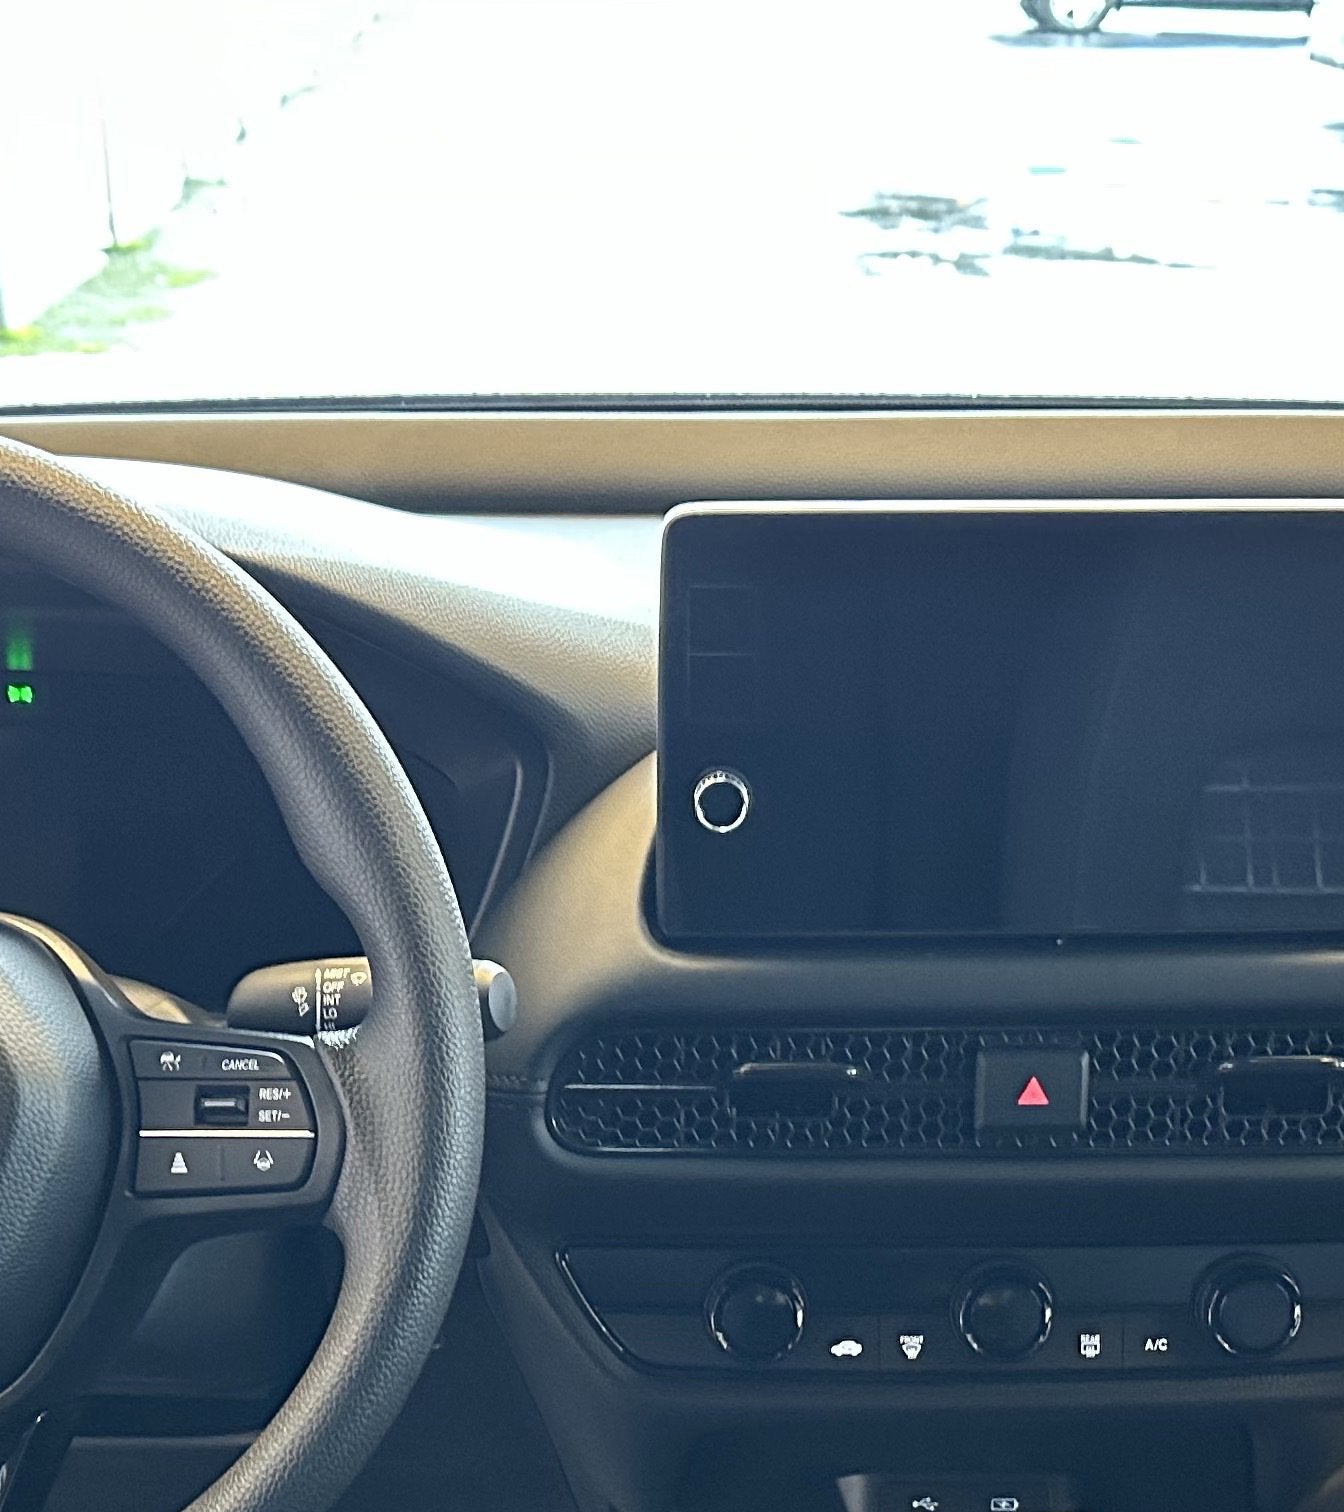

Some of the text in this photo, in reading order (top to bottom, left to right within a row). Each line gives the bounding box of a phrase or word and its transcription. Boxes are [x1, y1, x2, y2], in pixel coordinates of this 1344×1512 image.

[322, 981, 345, 994] OFF
[322, 993, 341, 1006] INT
[322, 1006, 338, 1019] LO
[221, 1058, 260, 1071] CANCEL
[1144, 1338, 1168, 1351] A/C
